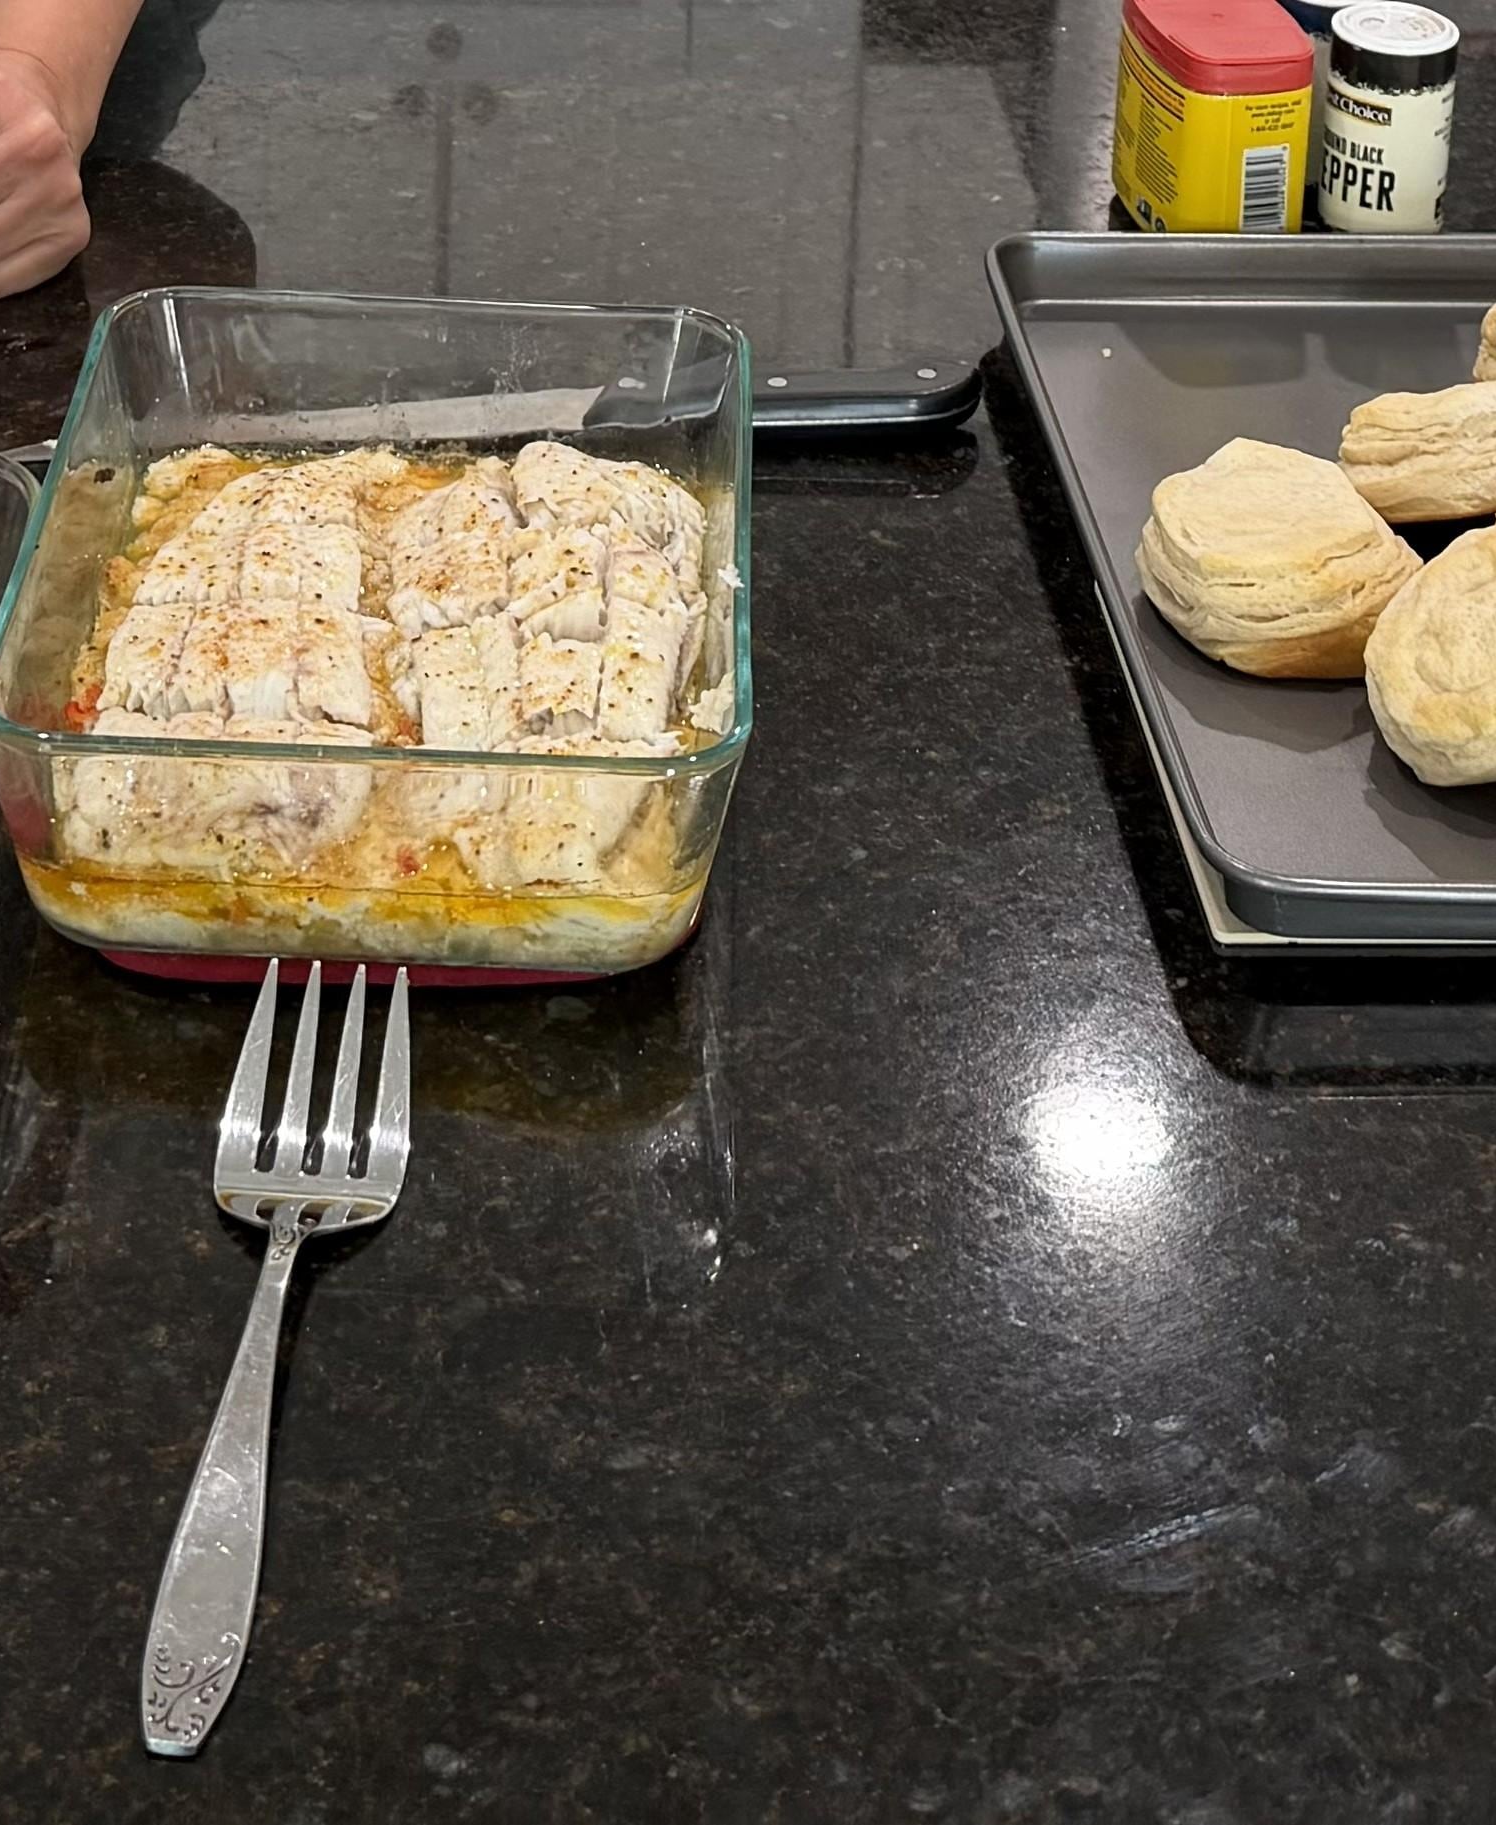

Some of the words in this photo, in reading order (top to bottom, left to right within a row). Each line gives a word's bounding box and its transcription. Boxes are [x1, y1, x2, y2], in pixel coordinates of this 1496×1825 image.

[1340, 98, 1389, 122] Choice
[1350, 141, 1385, 165] BLACK
[1320, 147, 1395, 212] EPPER
